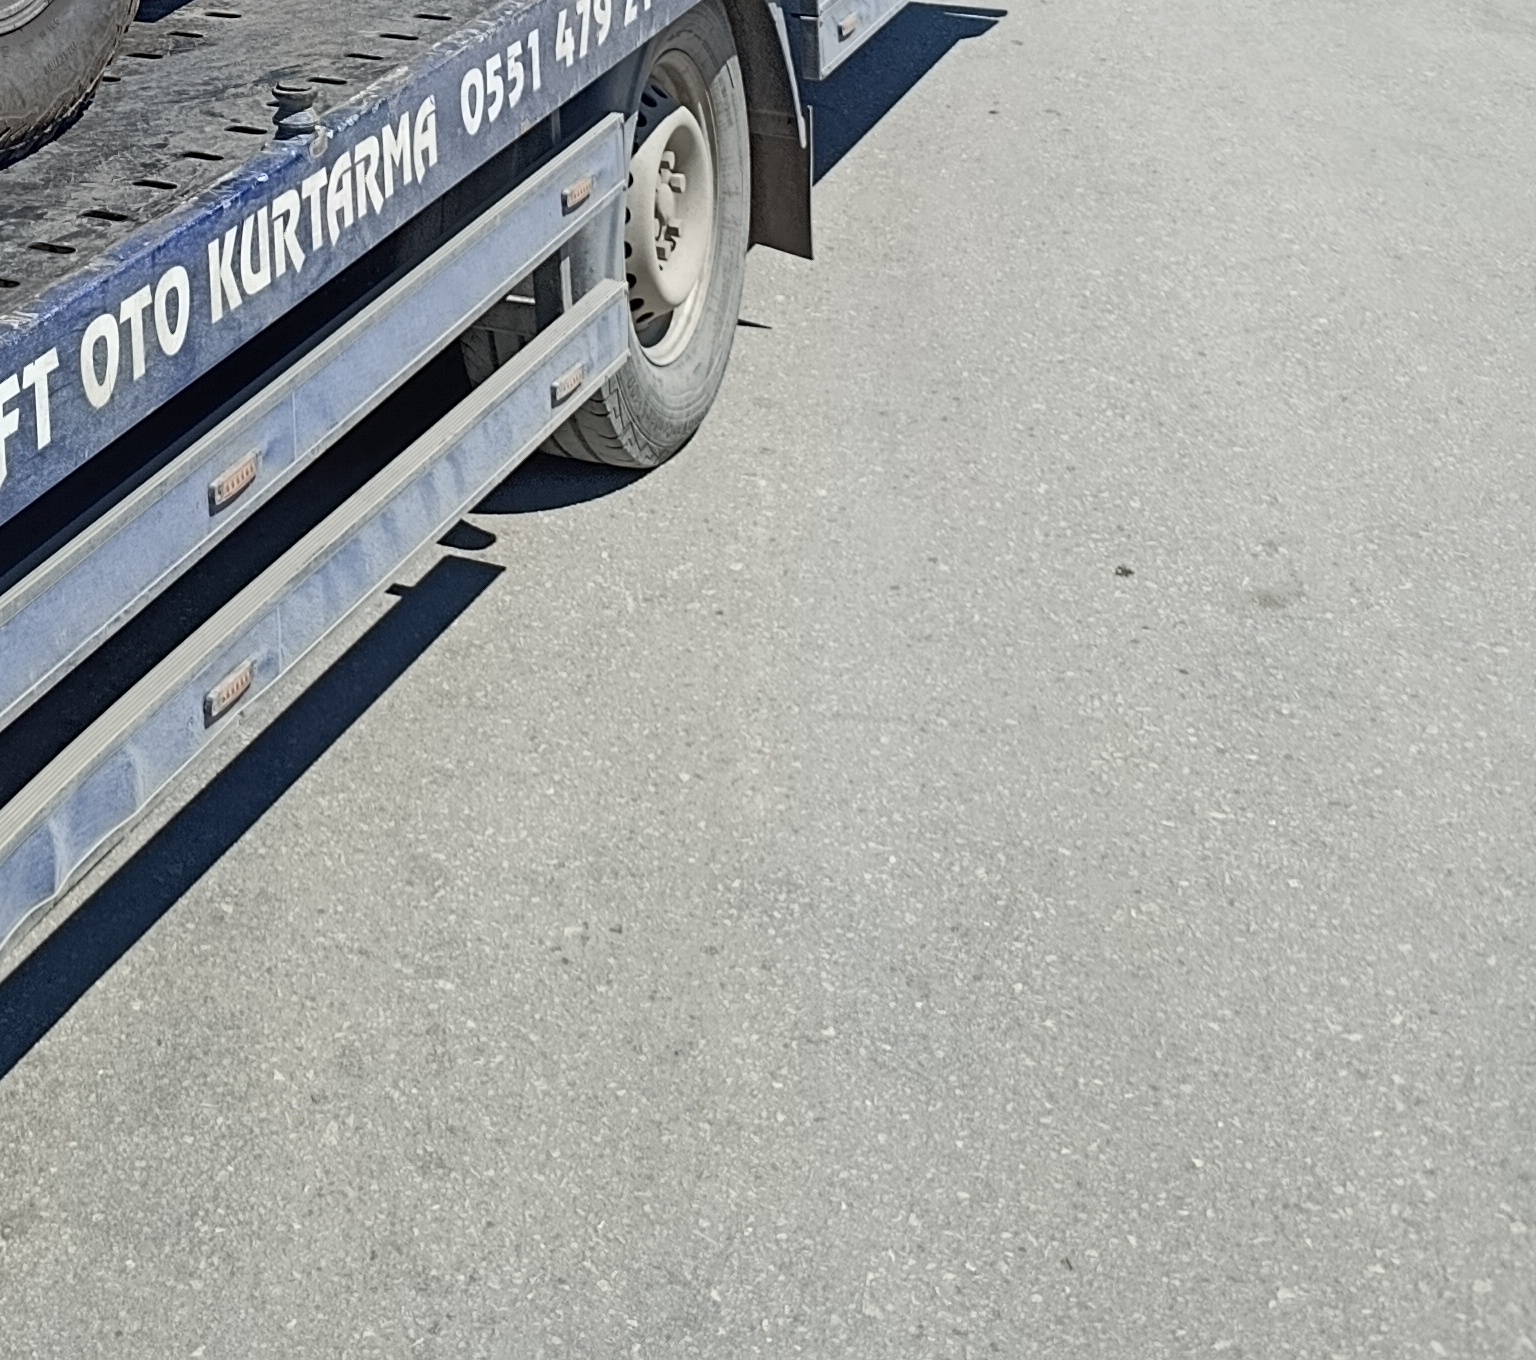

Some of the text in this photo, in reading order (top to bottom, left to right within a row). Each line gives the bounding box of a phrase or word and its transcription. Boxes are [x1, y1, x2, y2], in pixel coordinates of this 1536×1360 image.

[80, 265, 191, 410] OTO
[207, 95, 438, 324] KURTARMA
[460, 28, 541, 136] 0551
